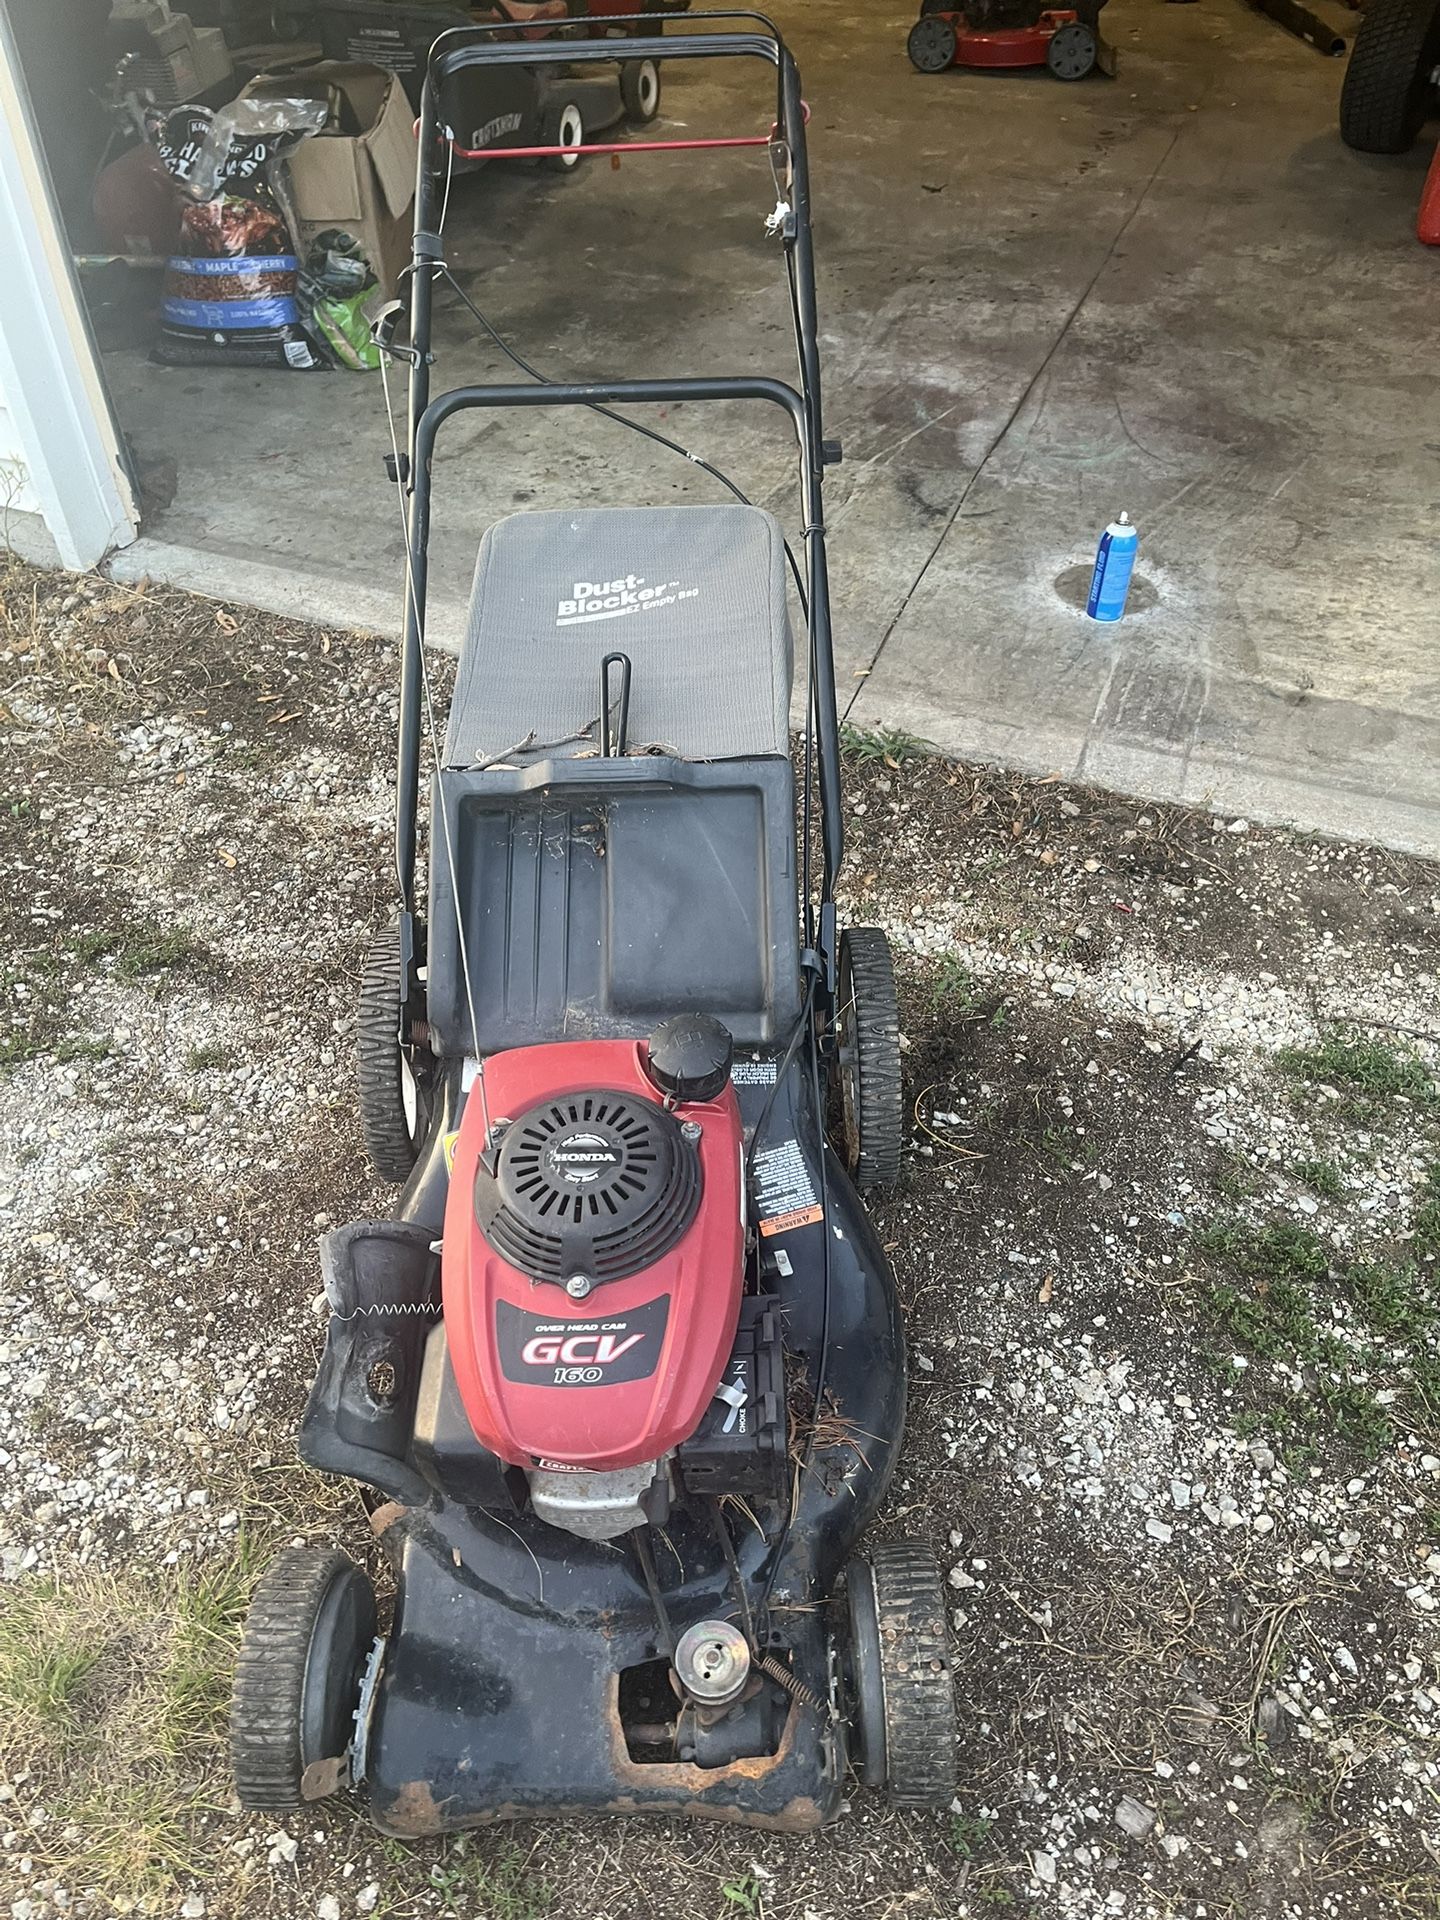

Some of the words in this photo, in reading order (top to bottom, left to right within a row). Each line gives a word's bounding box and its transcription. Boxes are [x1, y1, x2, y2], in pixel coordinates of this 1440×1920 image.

[205, 261, 239, 273] MAPLE
[573, 574, 645, 600] Dust-
[557, 583, 667, 617] Blocker
[625, 603, 641, 615] EZ
[642, 594, 677, 611] Empty
[678, 587, 699, 601] Bag
[554, 1153, 616, 1162] HONDA
[775, 1217, 802, 1231] WARNING
[535, 1325, 565, 1333] OVER
[567, 1324, 599, 1332] HEAD
[601, 1323, 627, 1331] CAM
[521, 1333, 646, 1365] GCV
[553, 1367, 603, 1385] 160
